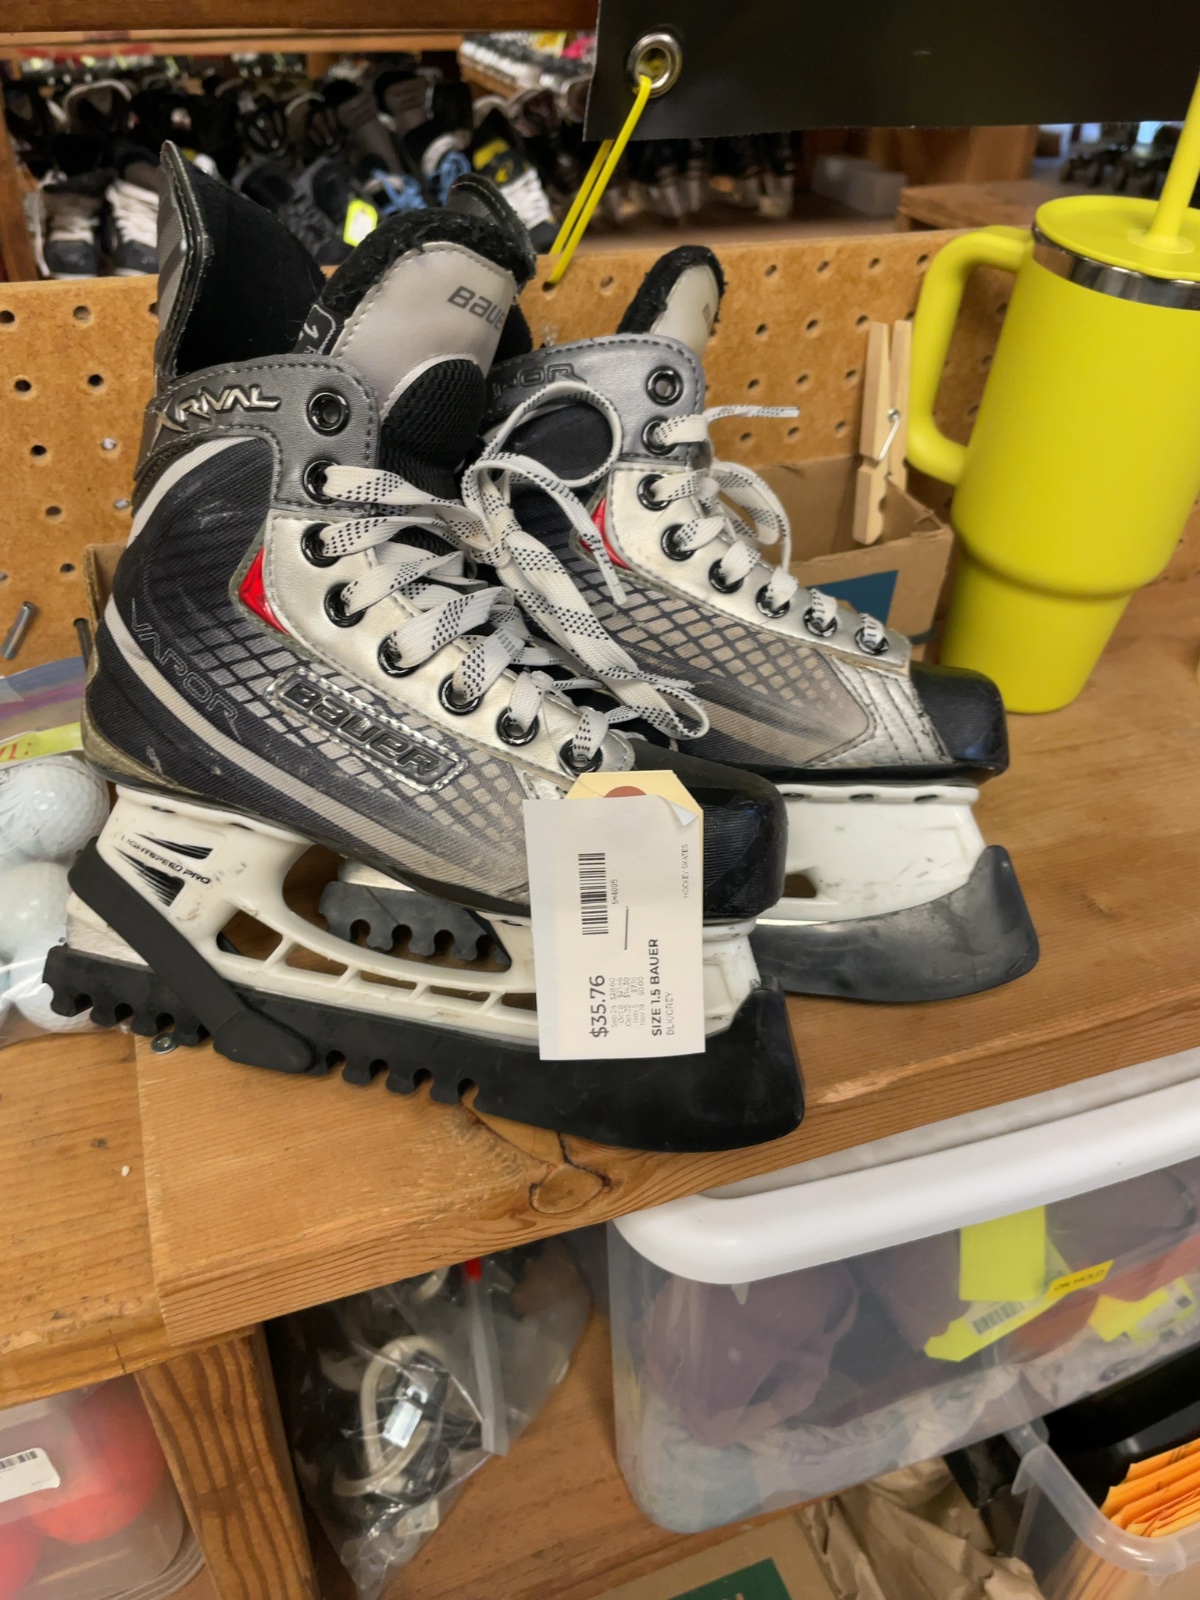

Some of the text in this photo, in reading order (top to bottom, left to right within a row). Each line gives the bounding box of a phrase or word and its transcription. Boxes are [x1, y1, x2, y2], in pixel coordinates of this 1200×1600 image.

[120, 834, 211, 885] LIGHTSPEED PRO
[681, 843, 689, 899] HOCKEY SKATES
[589, 975, 609, 1038] $35.76
[648, 938, 662, 1036] SIZE 1.5 BAUER
